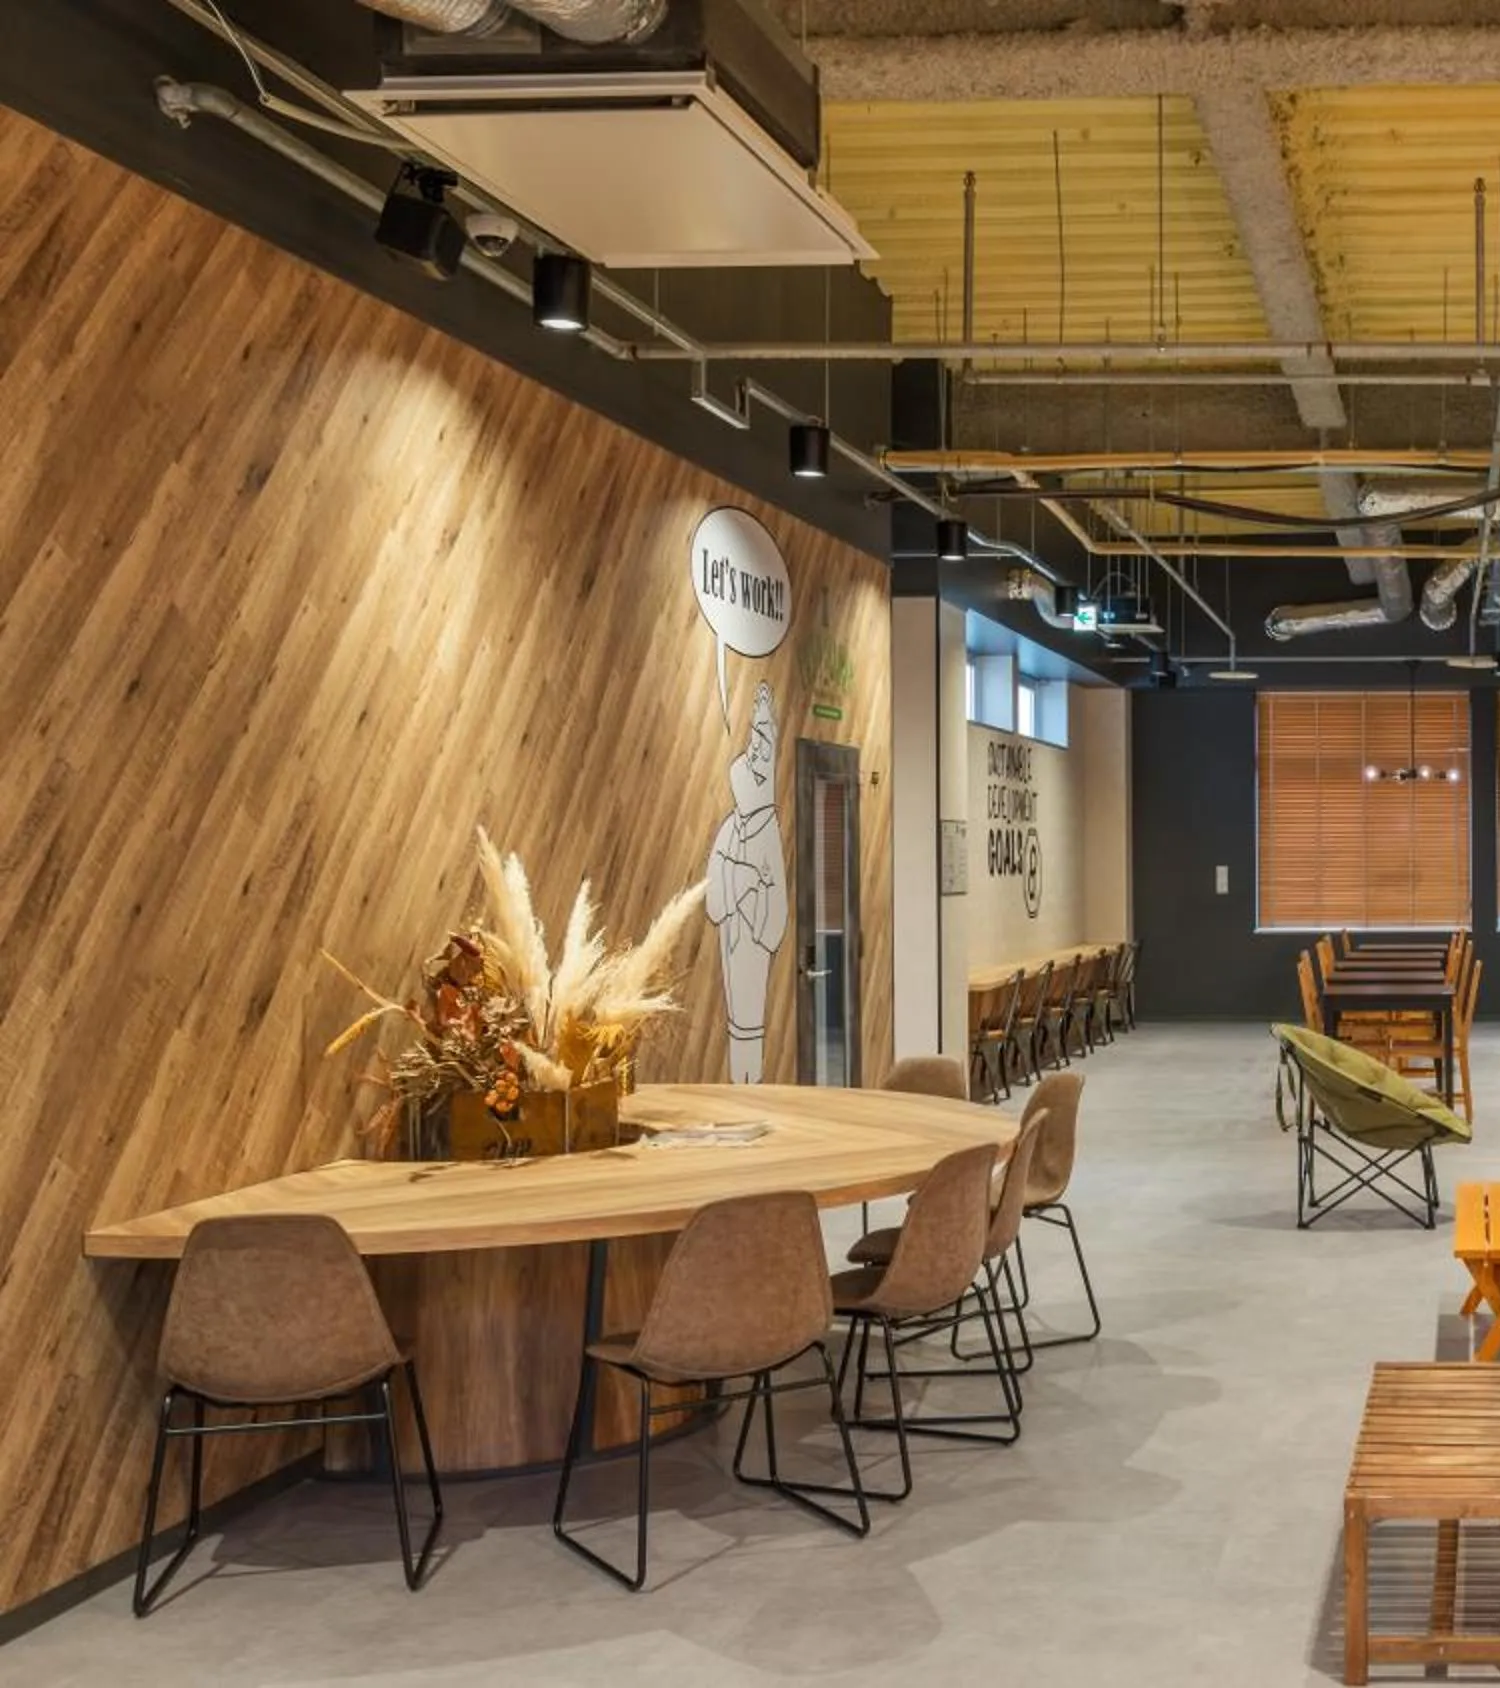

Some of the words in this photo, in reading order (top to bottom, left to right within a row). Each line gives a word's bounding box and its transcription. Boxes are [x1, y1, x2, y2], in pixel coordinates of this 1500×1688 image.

[703, 547, 737, 604] Let's
[740, 571, 784, 621] work!!
[988, 828, 1022, 876] GOALS
